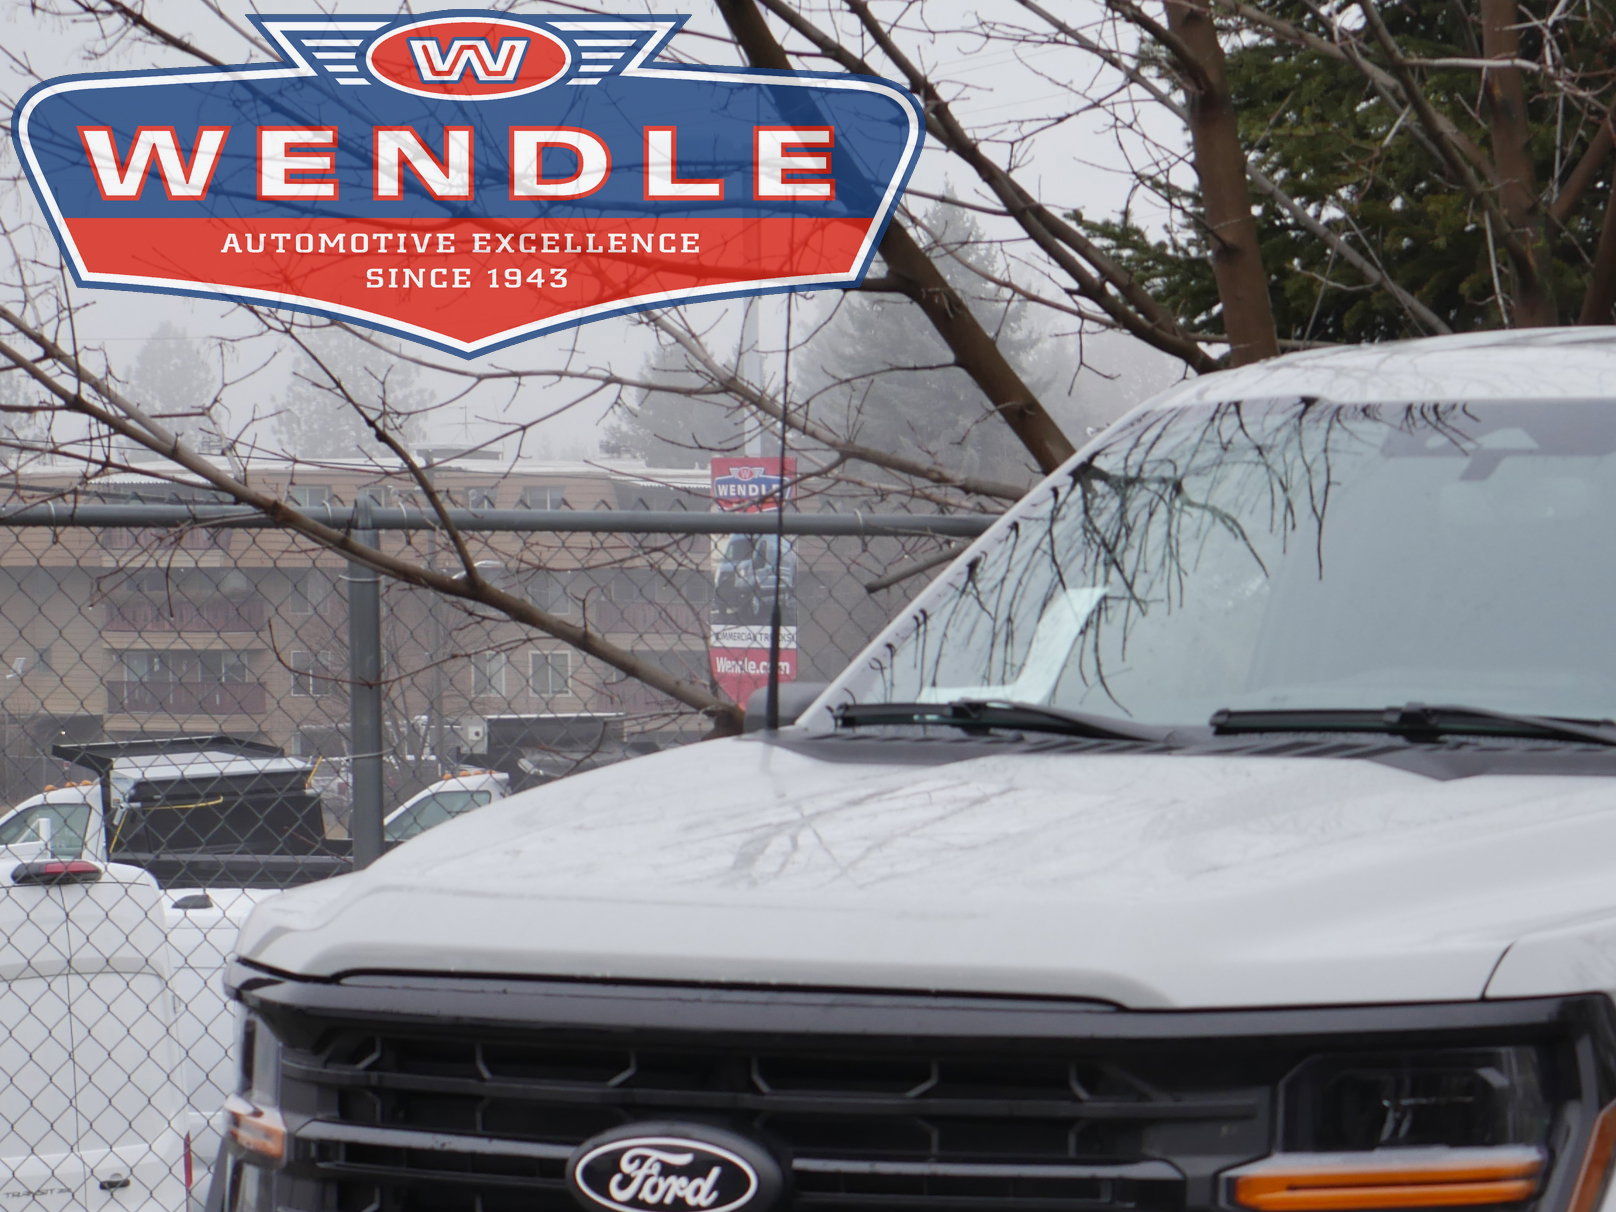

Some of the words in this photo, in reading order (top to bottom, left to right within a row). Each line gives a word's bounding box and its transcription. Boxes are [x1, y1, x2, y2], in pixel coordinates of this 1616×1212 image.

[715, 631, 757, 642] OMMERCIA
[716, 656, 790, 675] Wenle.cm
[609, 1148, 722, 1207] Ford
